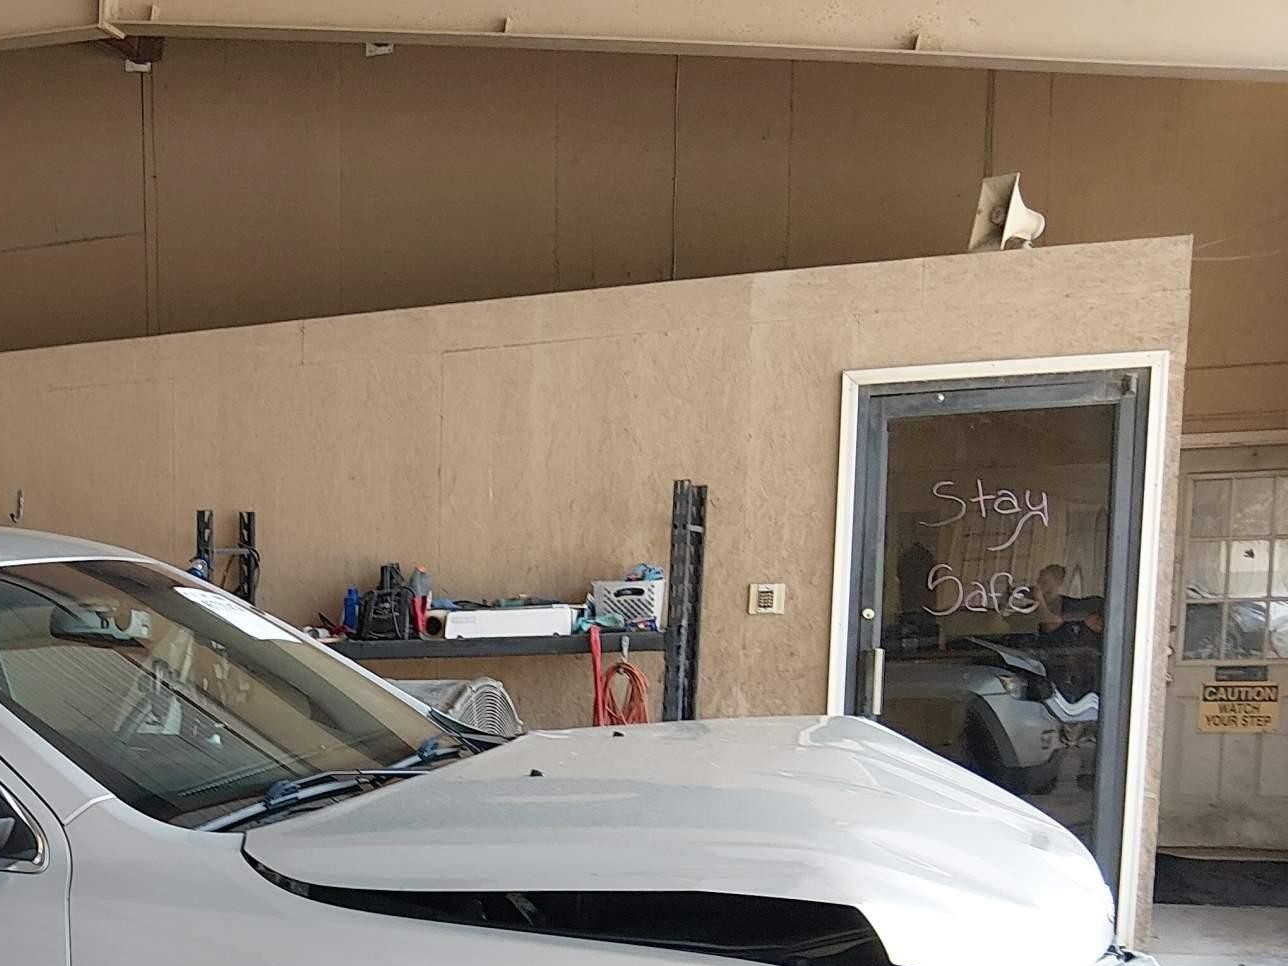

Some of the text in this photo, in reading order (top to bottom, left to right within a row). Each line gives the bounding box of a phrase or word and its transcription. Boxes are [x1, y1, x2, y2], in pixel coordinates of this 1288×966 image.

[918, 478, 1049, 552] Stay
[921, 563, 1041, 616] Safe
[1204, 686, 1277, 701] CAUTION
[1218, 703, 1261, 714] WATCH
[1204, 714, 1272, 727] YOUR STEP
